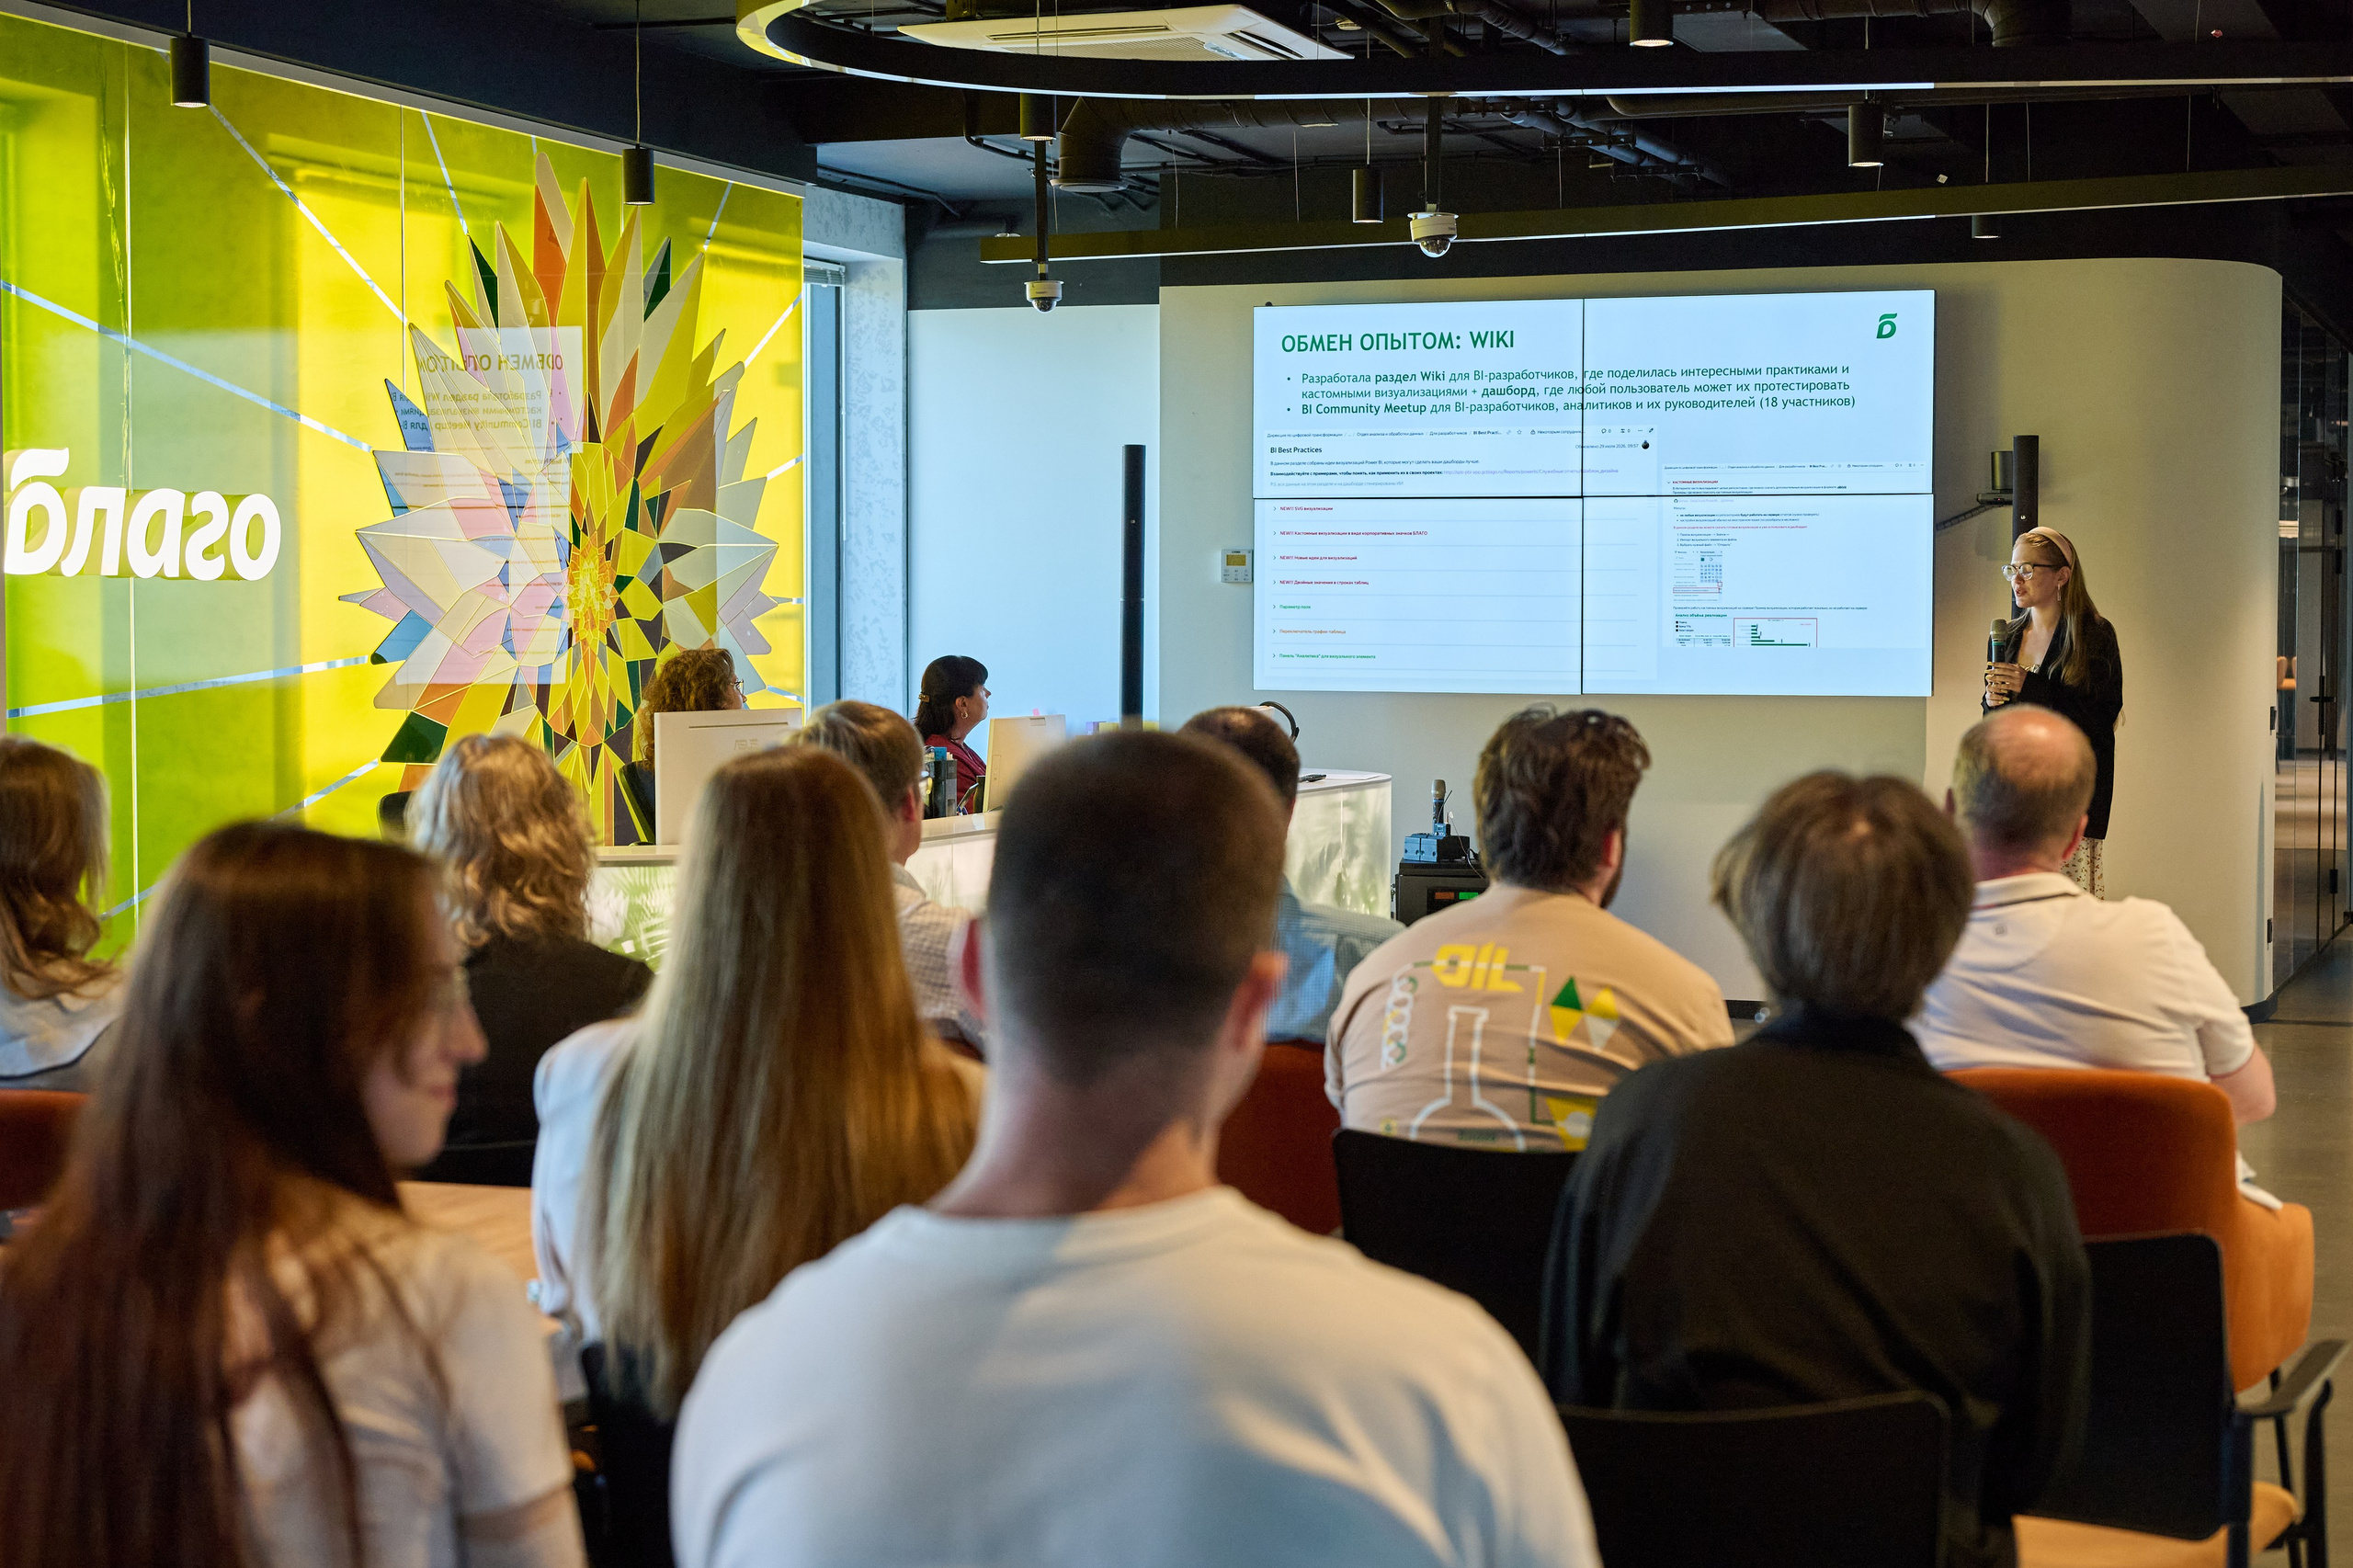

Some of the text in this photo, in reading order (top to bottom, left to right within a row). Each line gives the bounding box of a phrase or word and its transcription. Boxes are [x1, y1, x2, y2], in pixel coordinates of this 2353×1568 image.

[1282, 331, 1514, 352] ОБМЕН ОПЫТОМ: WIKI
[1302, 366, 1848, 385] Разработала раздел Wiki для BI-разработчиков, где поделилась интересными практиками и
[1302, 390, 1370, 399] кастомными
[1375, 389, 1467, 399] визуализациями
[1482, 385, 1539, 397] дашборд,
[1544, 386, 1563, 396] где
[1567, 383, 1606, 394] любой
[1610, 385, 1689, 393] пользователь
[1736, 383, 1750, 392] их
[1755, 382, 1849, 392] протестировать
[1302, 396, 1855, 415] BI Community Meetup для BI-разработчиков, аналитиков и их руководителей (18 участников)
[1431, 941, 1524, 993] OIL
